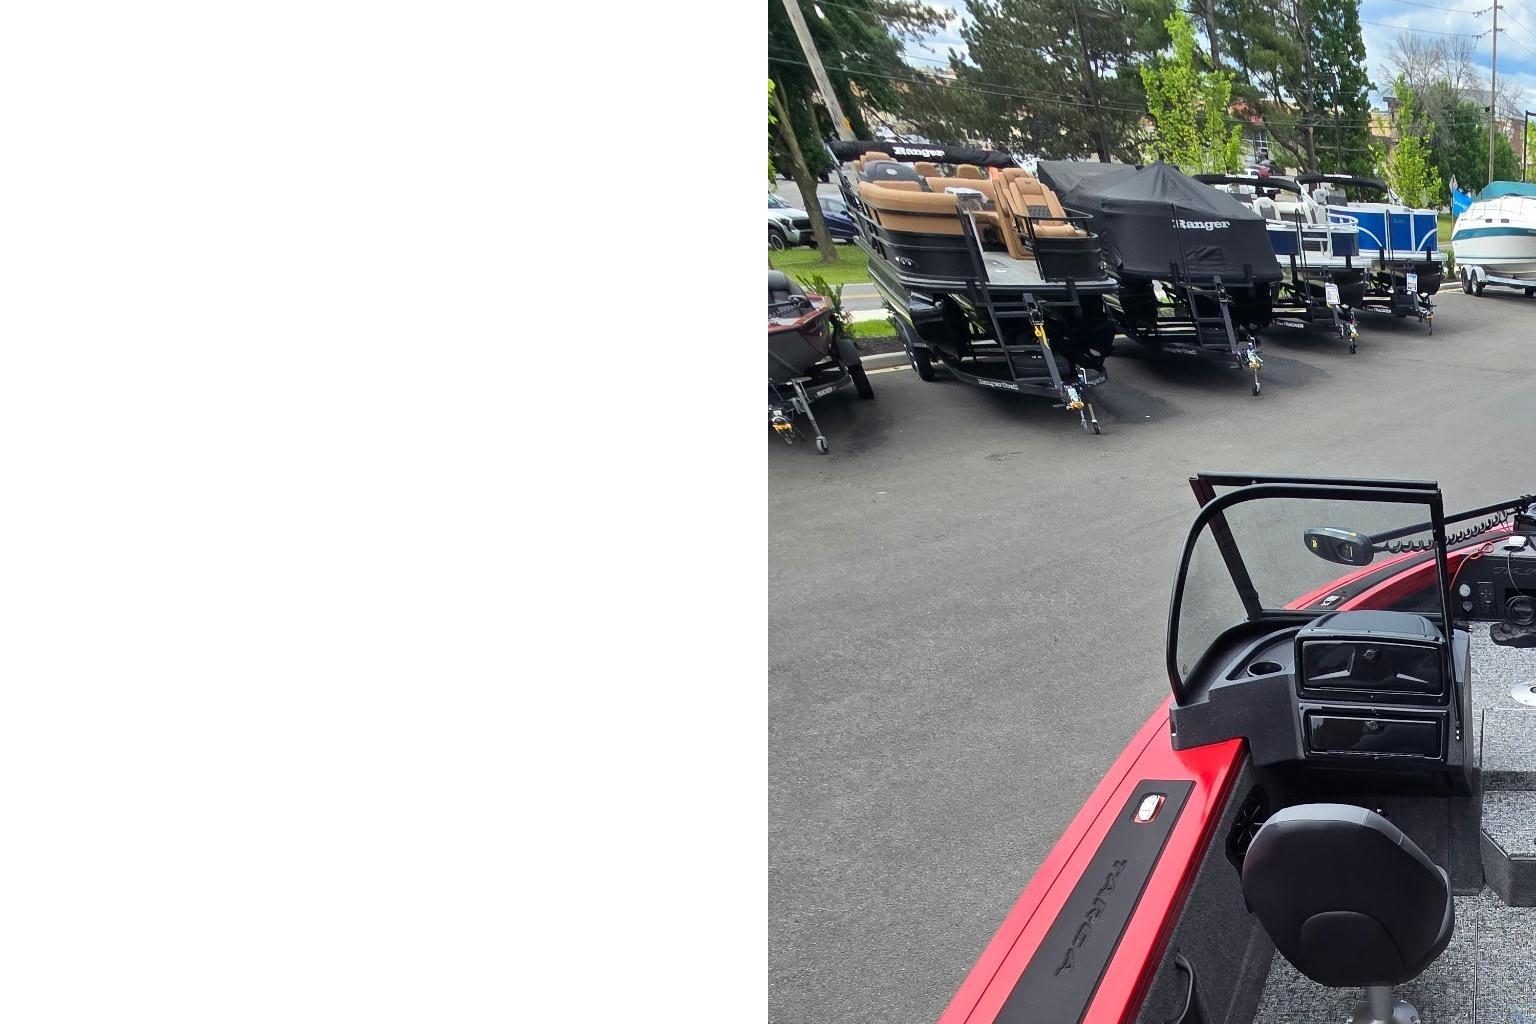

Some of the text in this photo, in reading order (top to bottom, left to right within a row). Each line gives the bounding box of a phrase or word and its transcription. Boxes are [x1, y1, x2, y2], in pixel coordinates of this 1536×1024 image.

[892, 146, 945, 158] Ranger
[1171, 219, 1230, 231] Ranger
[1053, 857, 1128, 976] TARGA
